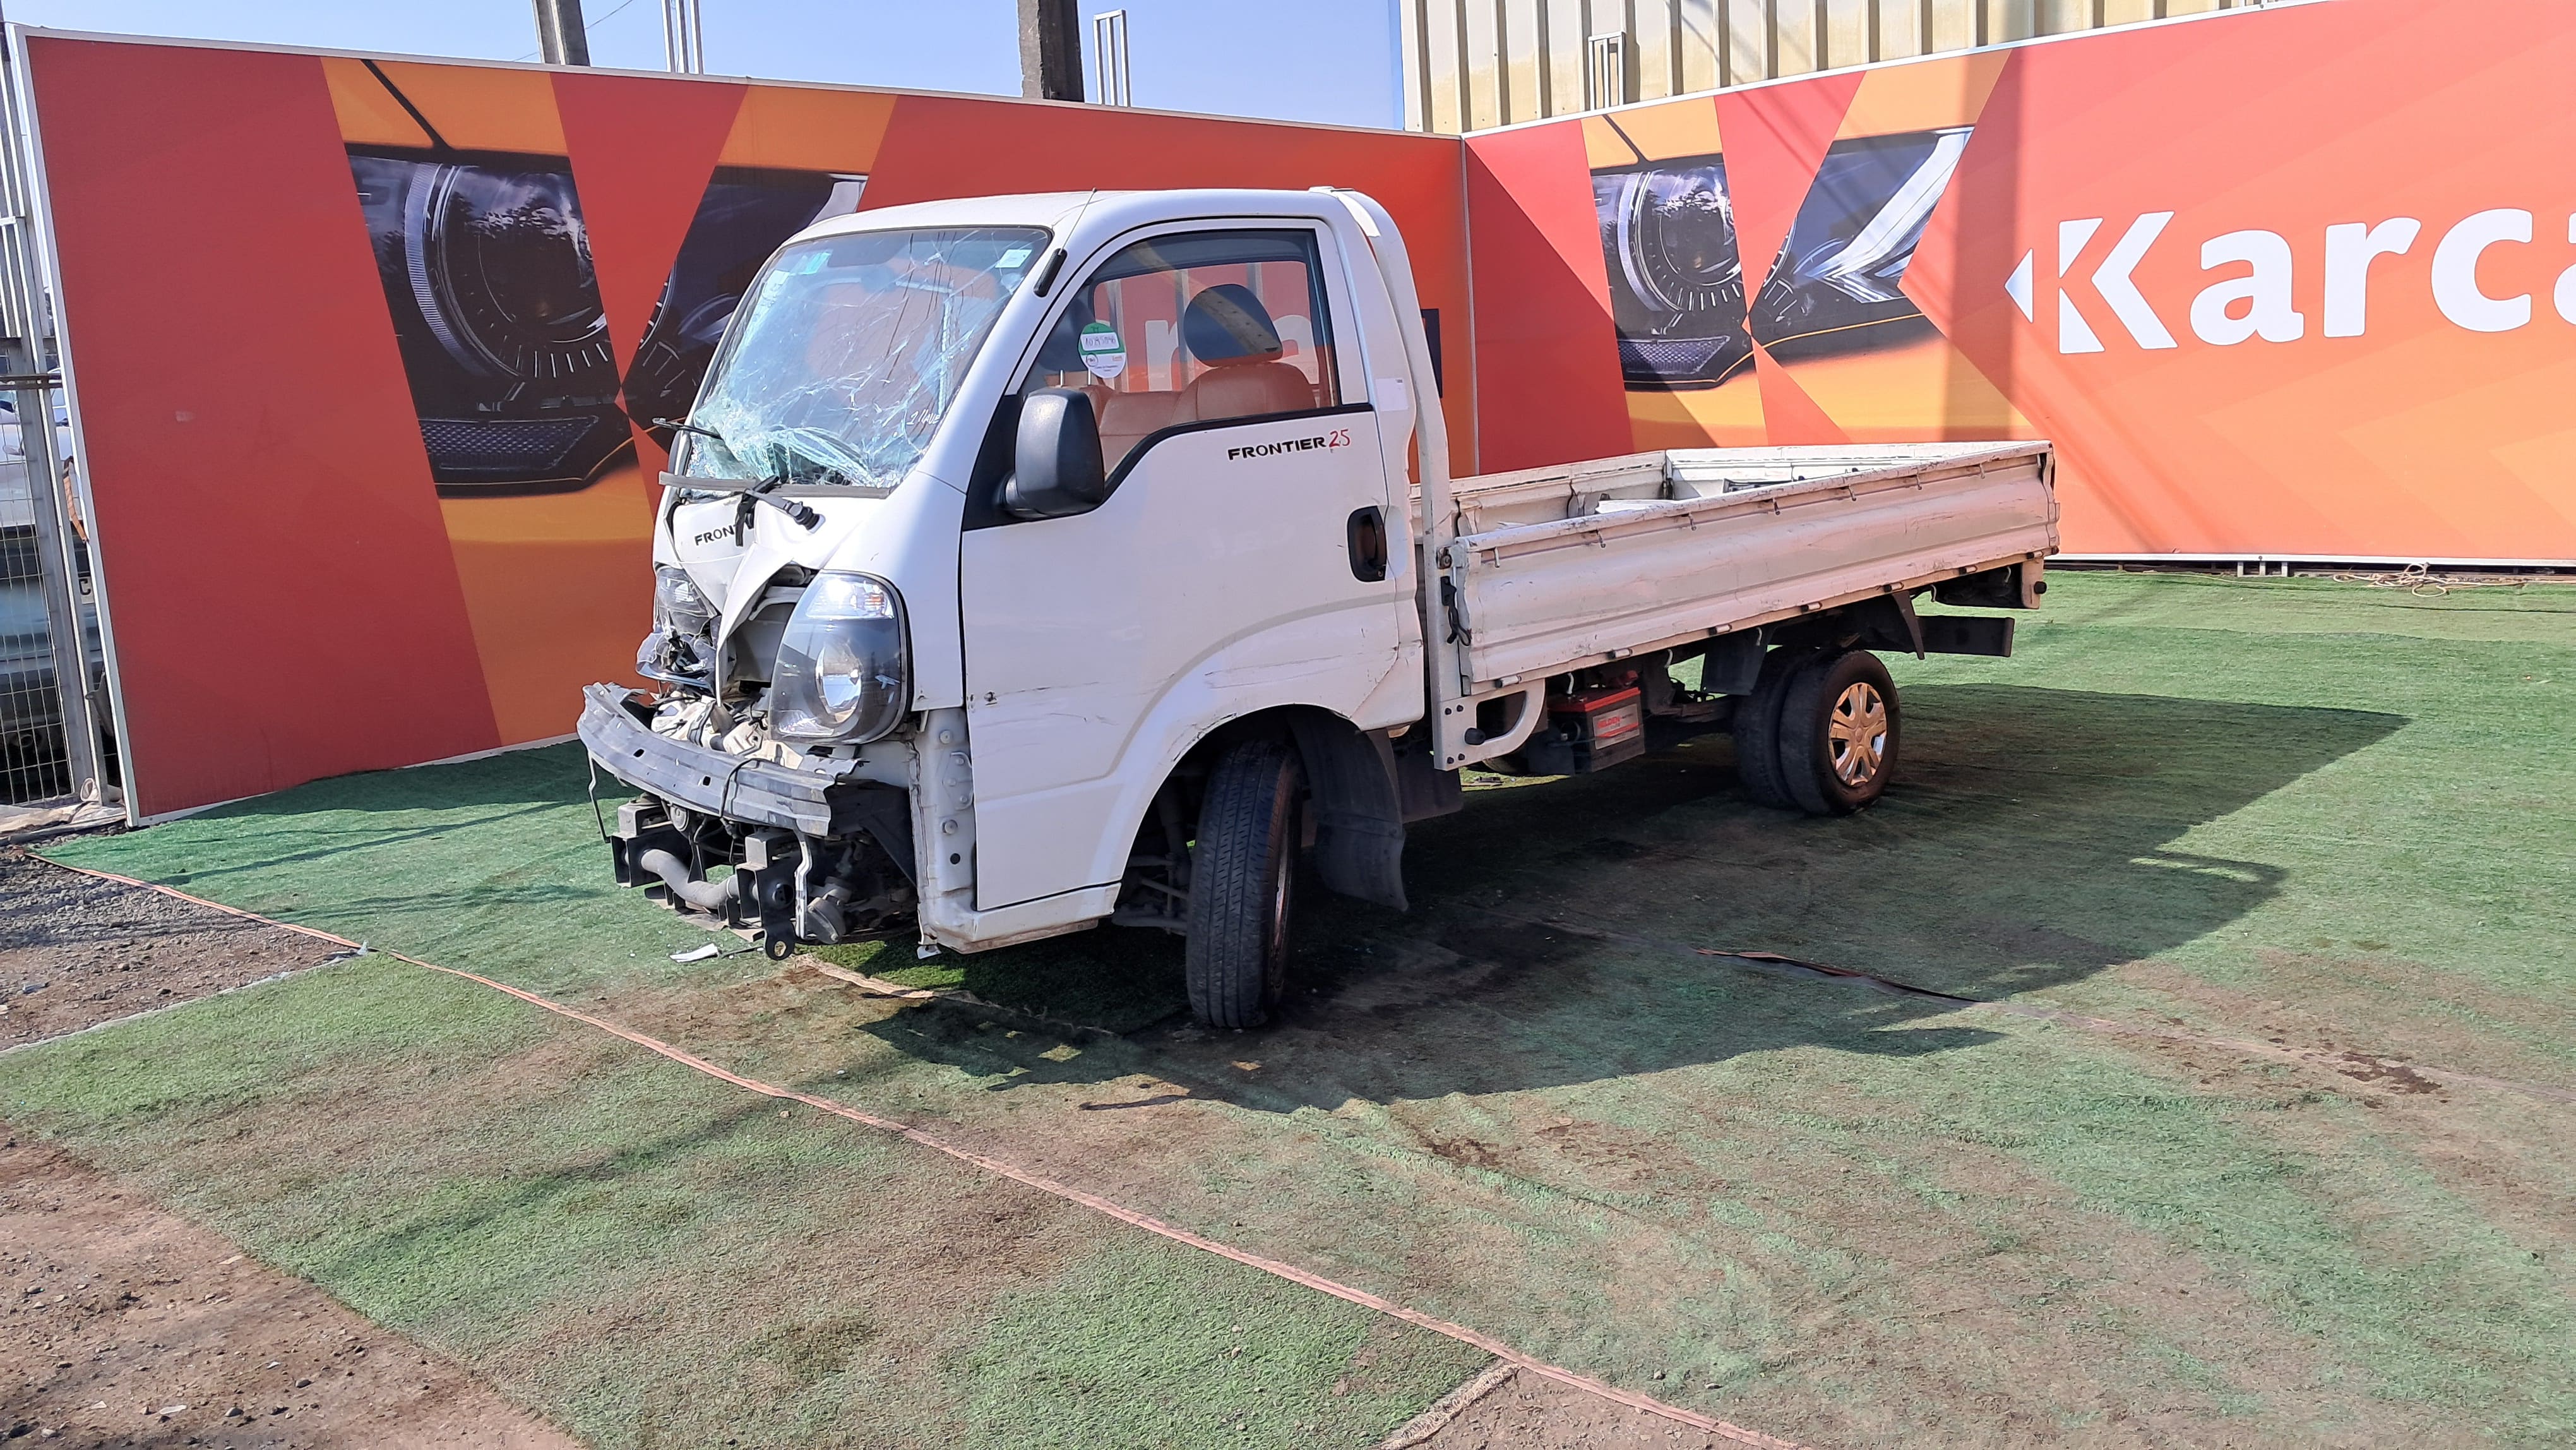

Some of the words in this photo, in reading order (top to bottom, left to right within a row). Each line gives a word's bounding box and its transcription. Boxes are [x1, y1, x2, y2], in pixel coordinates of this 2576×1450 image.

[2058, 207, 2576, 354] Karc
[1227, 436, 1327, 460] FRONTIER
[695, 524, 737, 546] FRON
